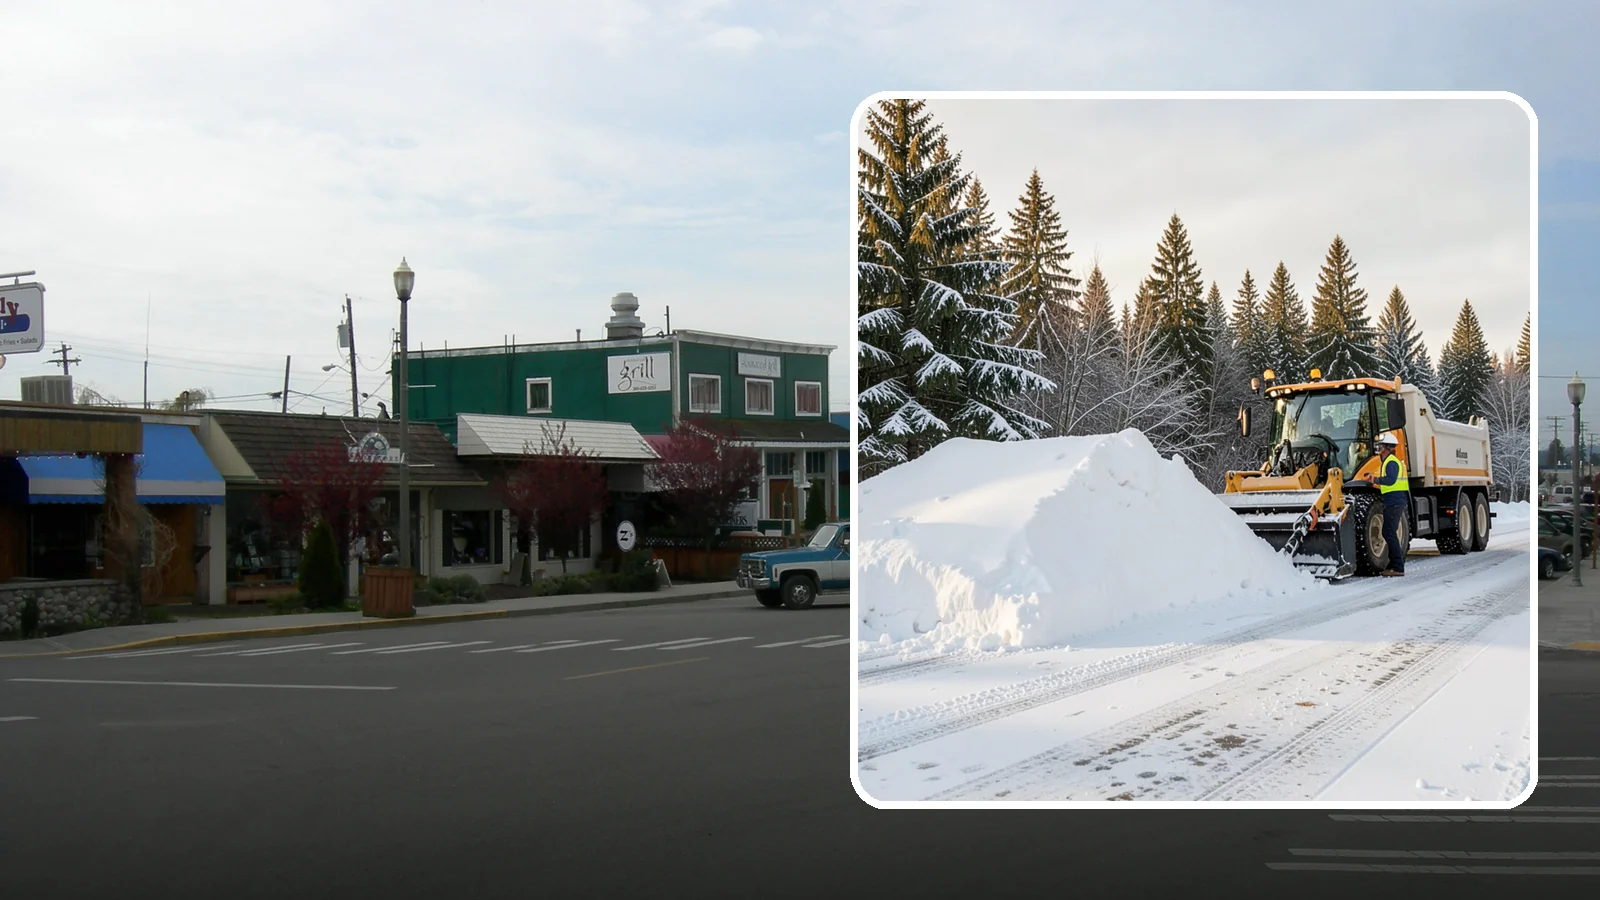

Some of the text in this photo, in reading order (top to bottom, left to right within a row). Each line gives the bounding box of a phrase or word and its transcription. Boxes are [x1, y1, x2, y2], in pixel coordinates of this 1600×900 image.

[3, 338, 16, 346] Fries
[20, 337, 38, 345] Salads
[618, 356, 655, 391] grill
